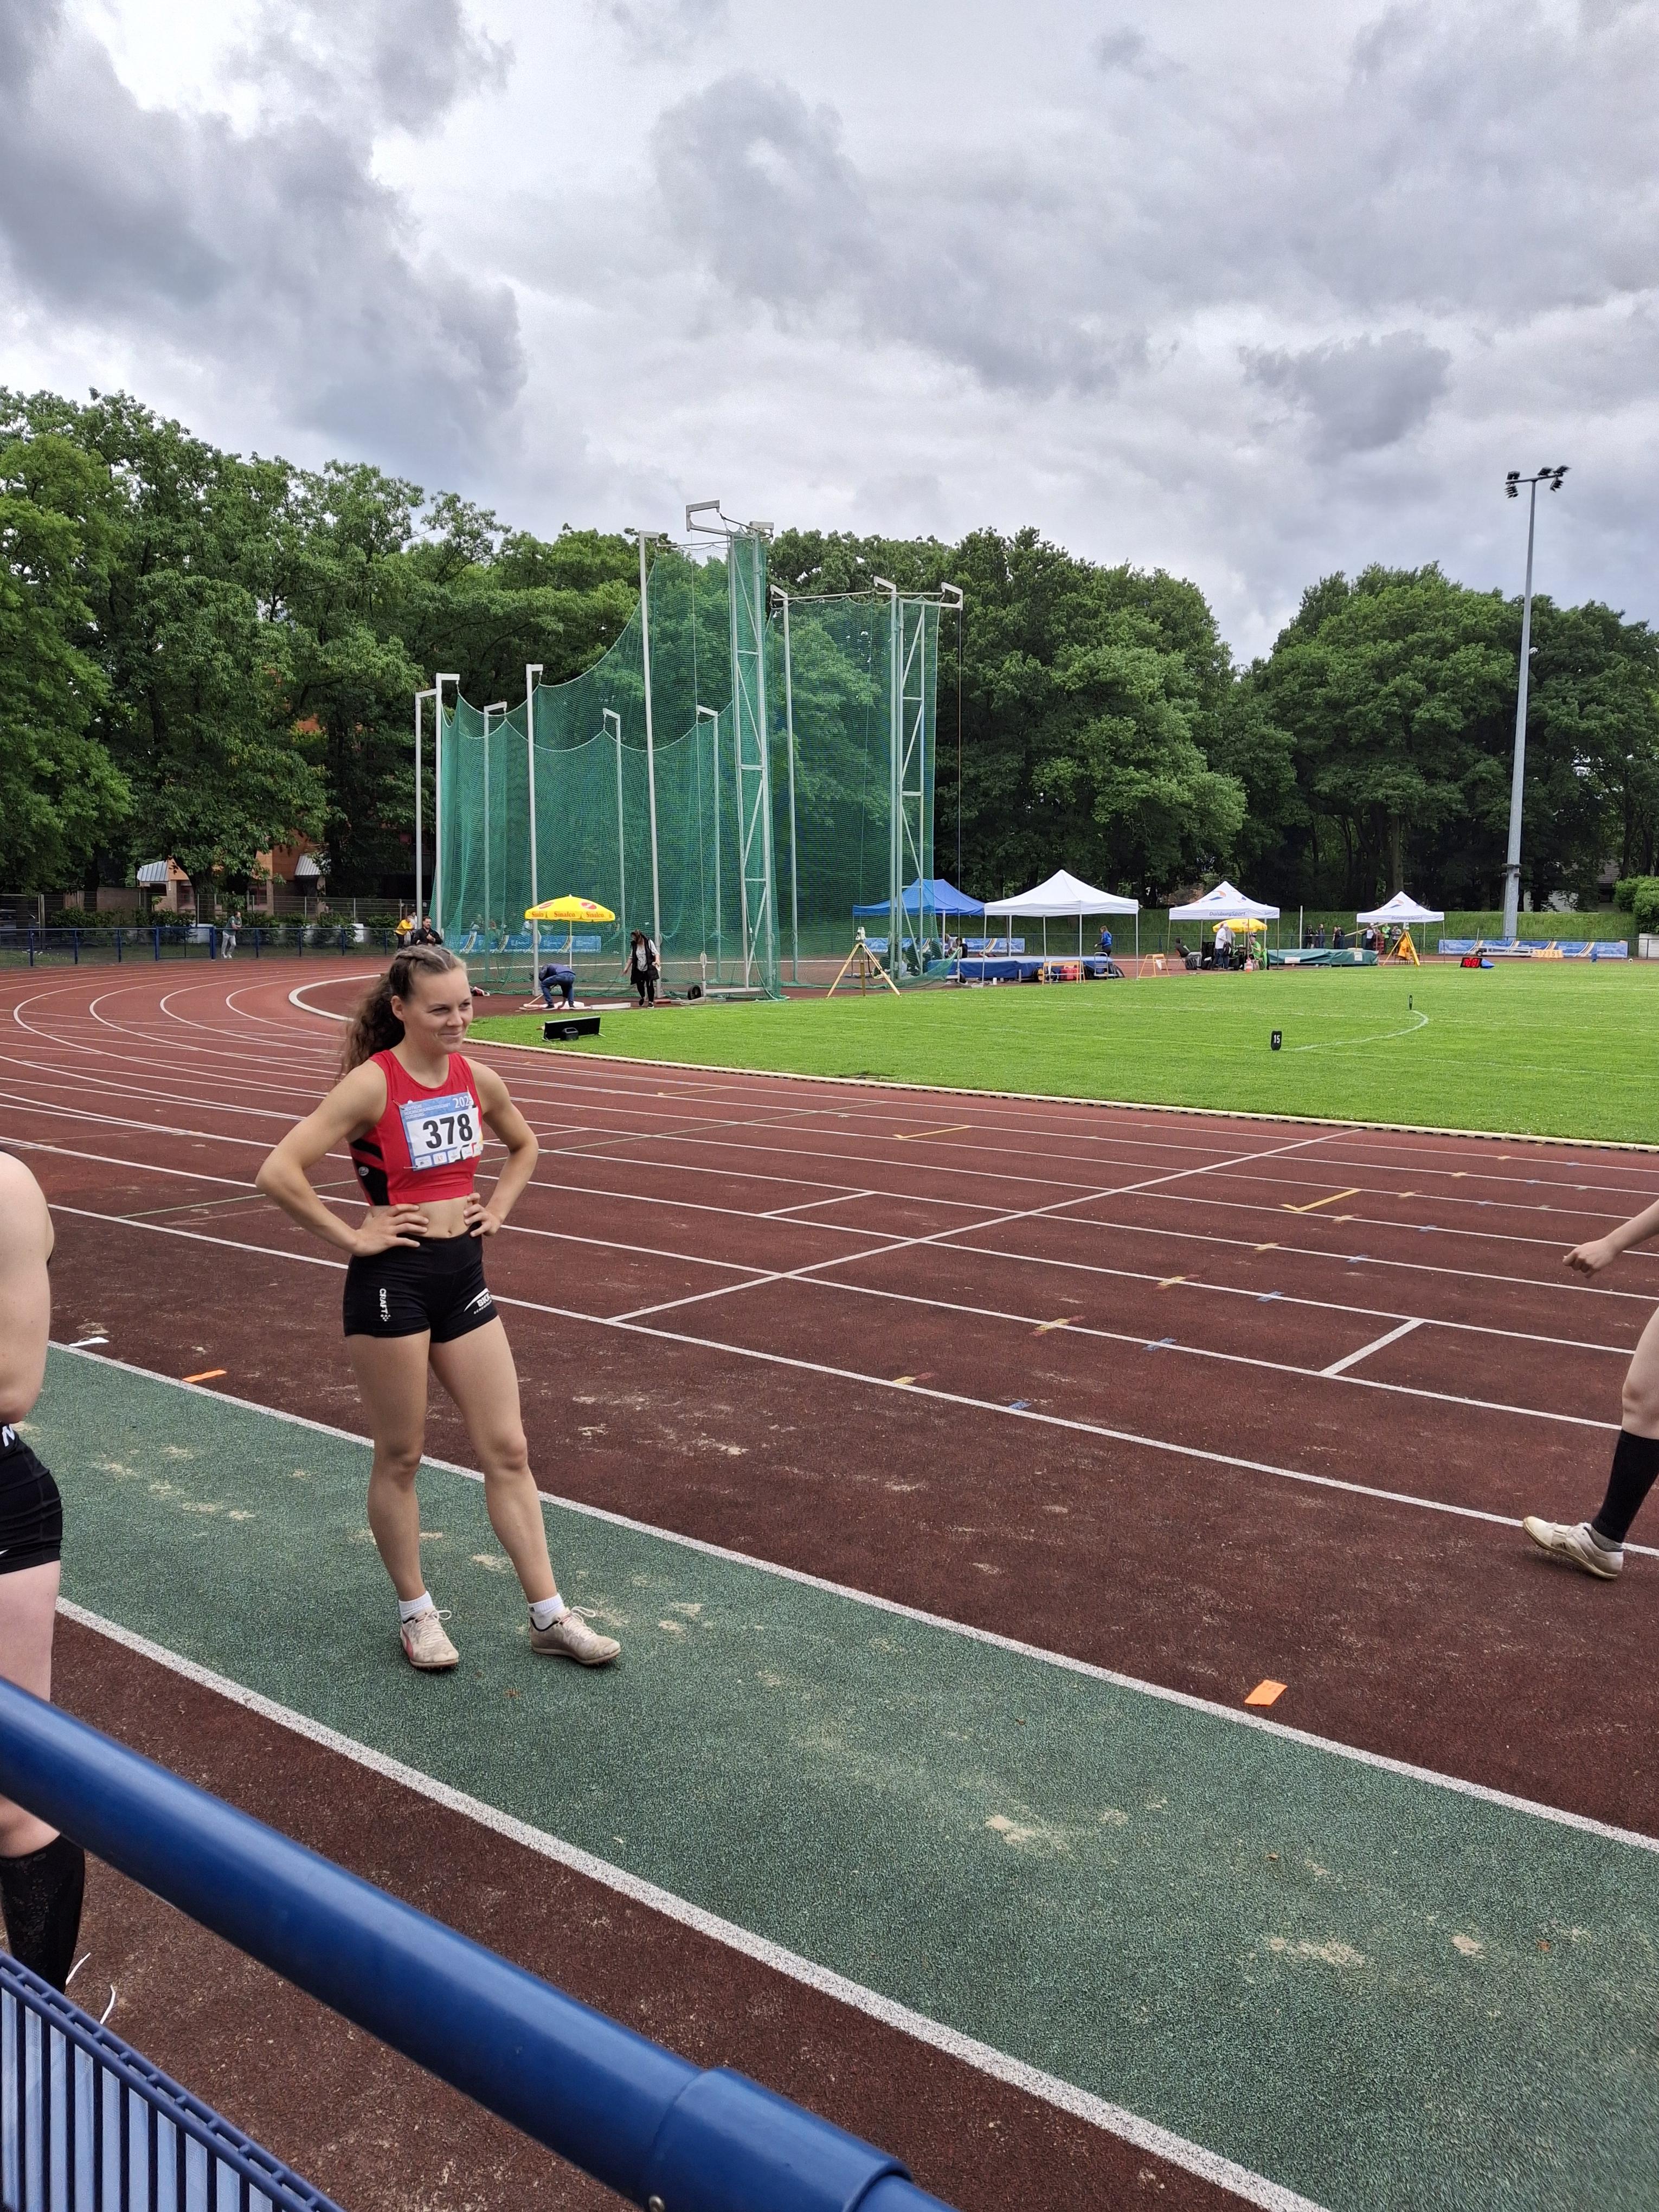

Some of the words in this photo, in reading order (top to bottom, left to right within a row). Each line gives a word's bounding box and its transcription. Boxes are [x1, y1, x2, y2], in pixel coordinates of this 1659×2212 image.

[1274, 1034, 1280, 1044] 15
[423, 1113, 473, 1149] 378
[380, 1288, 388, 1314] CRAFT
